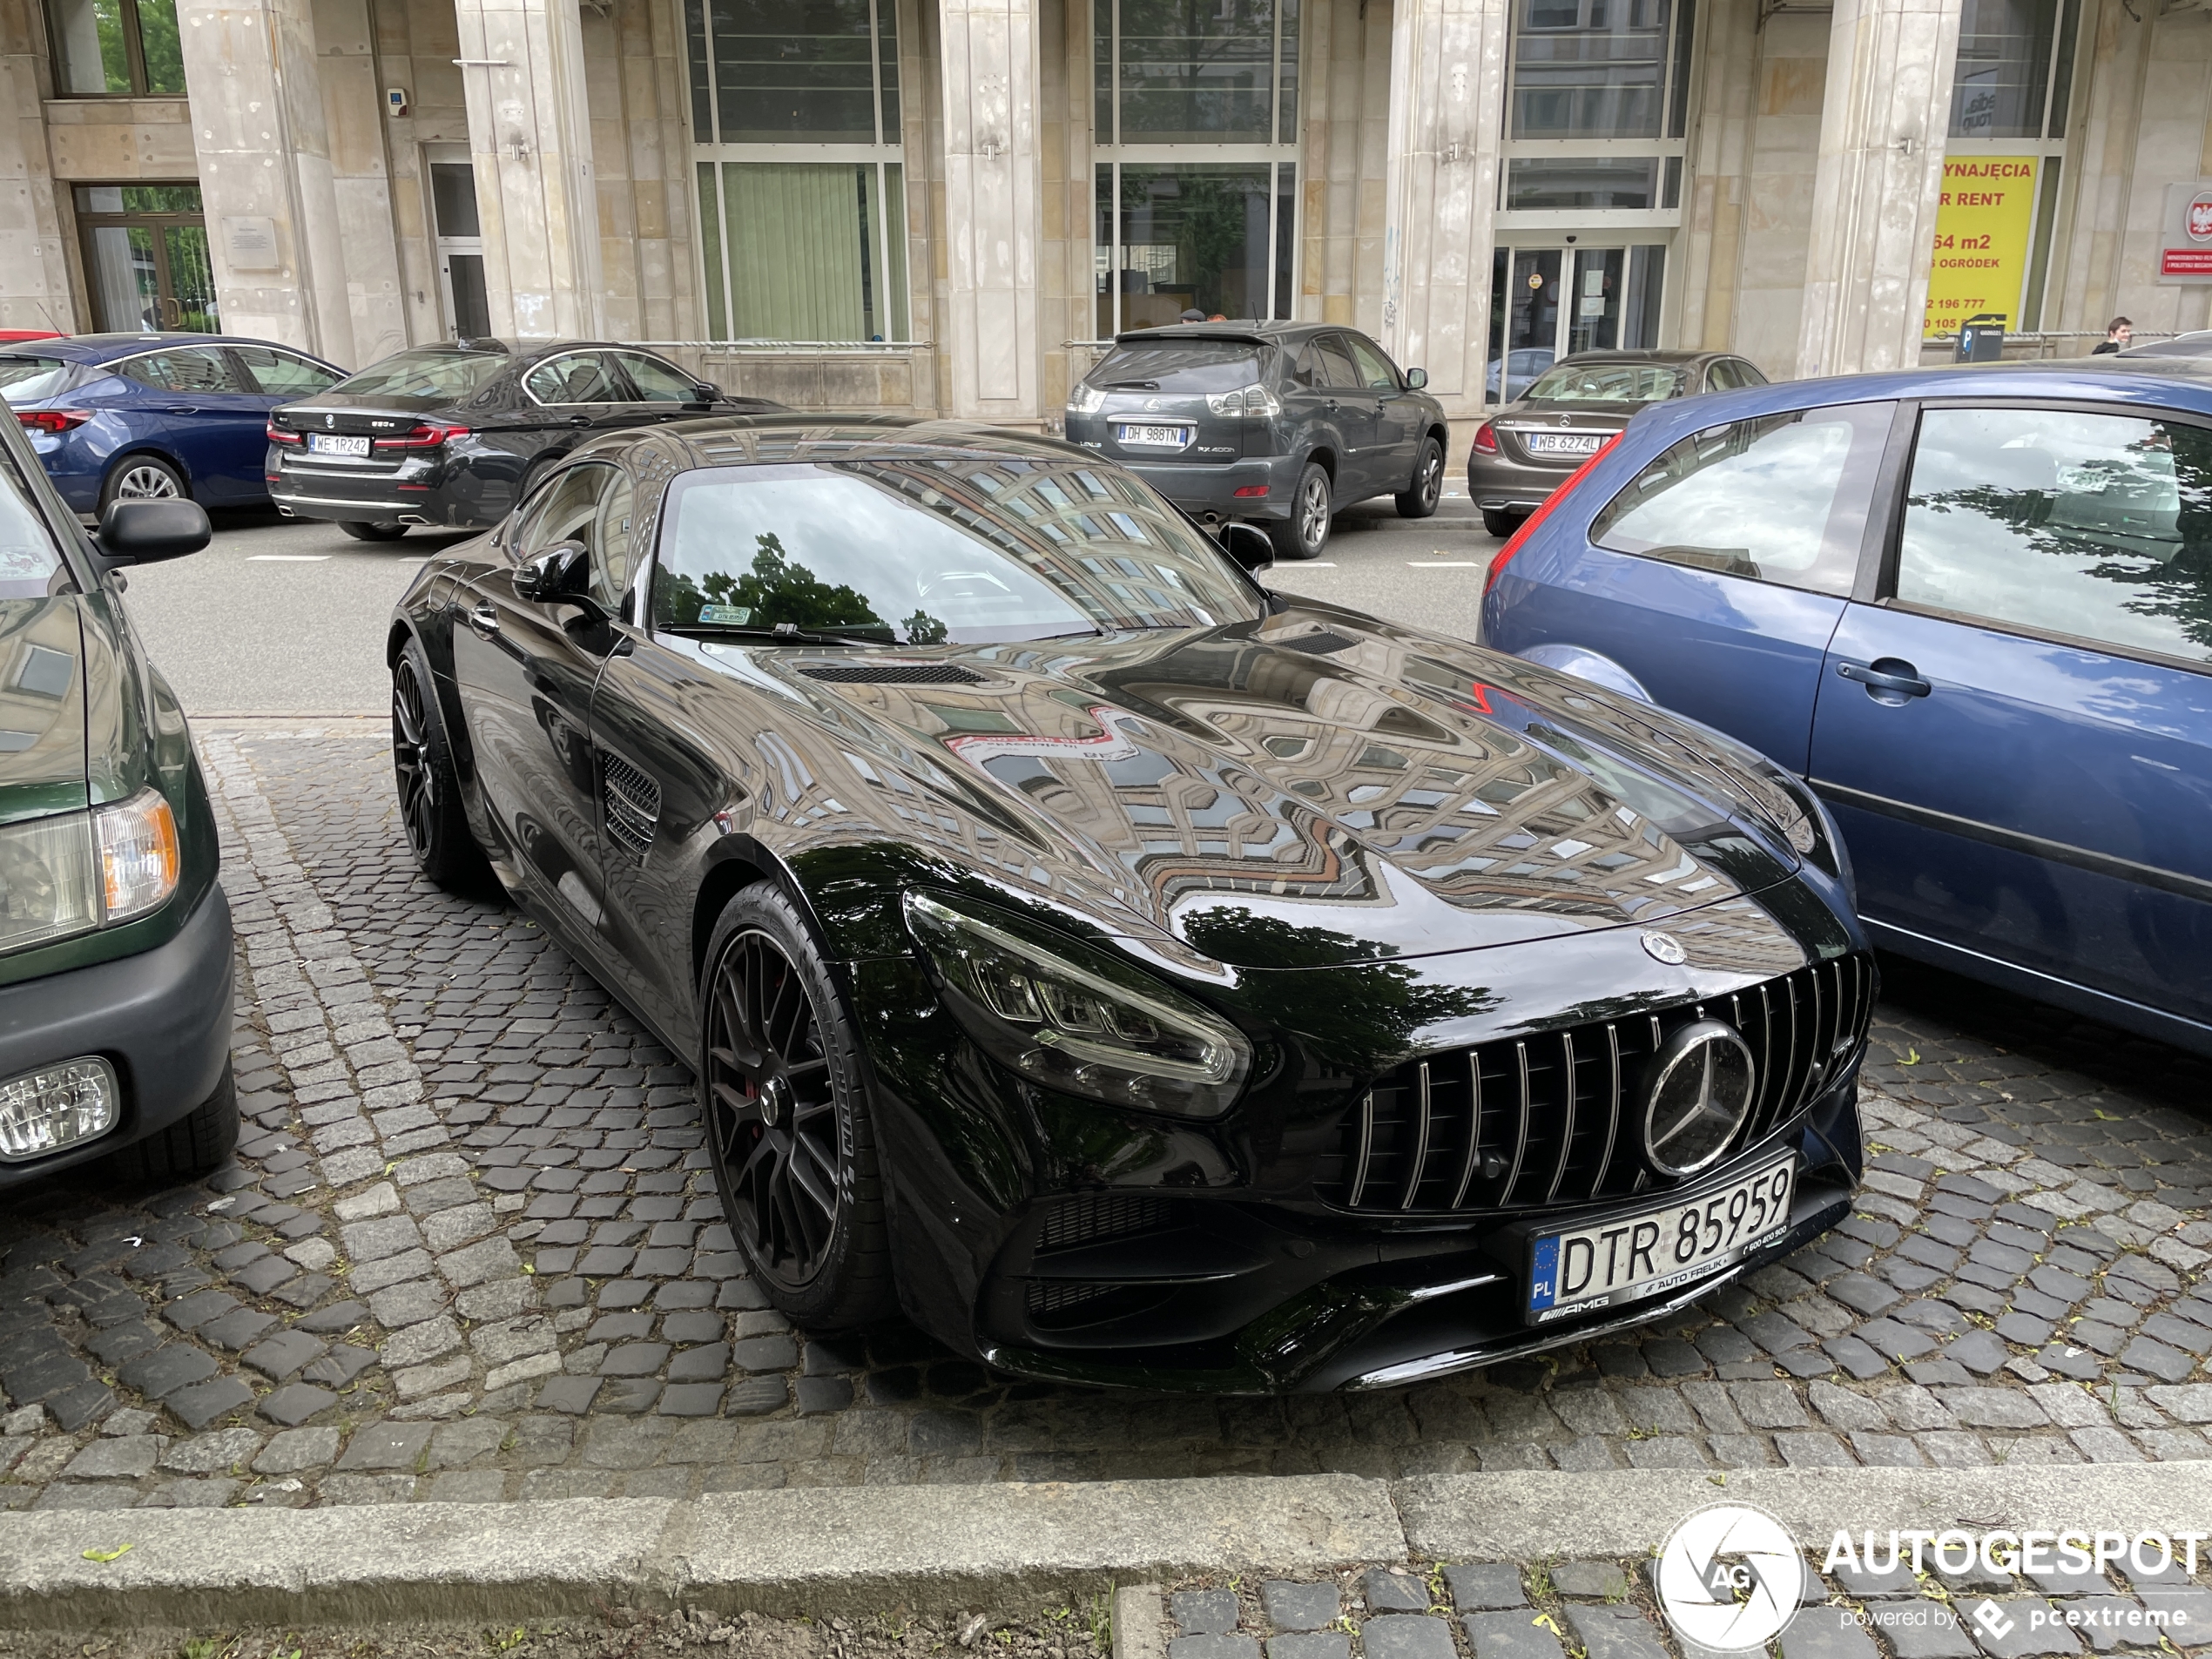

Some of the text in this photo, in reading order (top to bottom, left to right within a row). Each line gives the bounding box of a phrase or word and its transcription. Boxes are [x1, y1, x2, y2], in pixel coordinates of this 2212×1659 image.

[1943, 164, 2031, 180] YNAJĘCIA
[1939, 192, 2005, 206] R RENT
[1961, 234, 1991, 249] m2
[1939, 256, 2000, 268] OGRÓDEK
[1938, 299, 1959, 308] 196
[1964, 299, 1986, 308] 777
[1935, 319, 1957, 328] 105
[1963, 330, 1973, 347] P
[1128, 427, 1178, 442] DH 988TN
[317, 437, 367, 453] WE 1R242
[1538, 436, 1597, 450] WB 6274L
[1561, 1168, 1790, 1298] DTR 85959
[1561, 1296, 1609, 1317] AMG
[1657, 1272, 1688, 1290] AUTO
[1689, 1259, 1723, 1279] FRELIK
[1749, 1238, 1762, 1251] 600
[1533, 1280, 1552, 1299] PL
